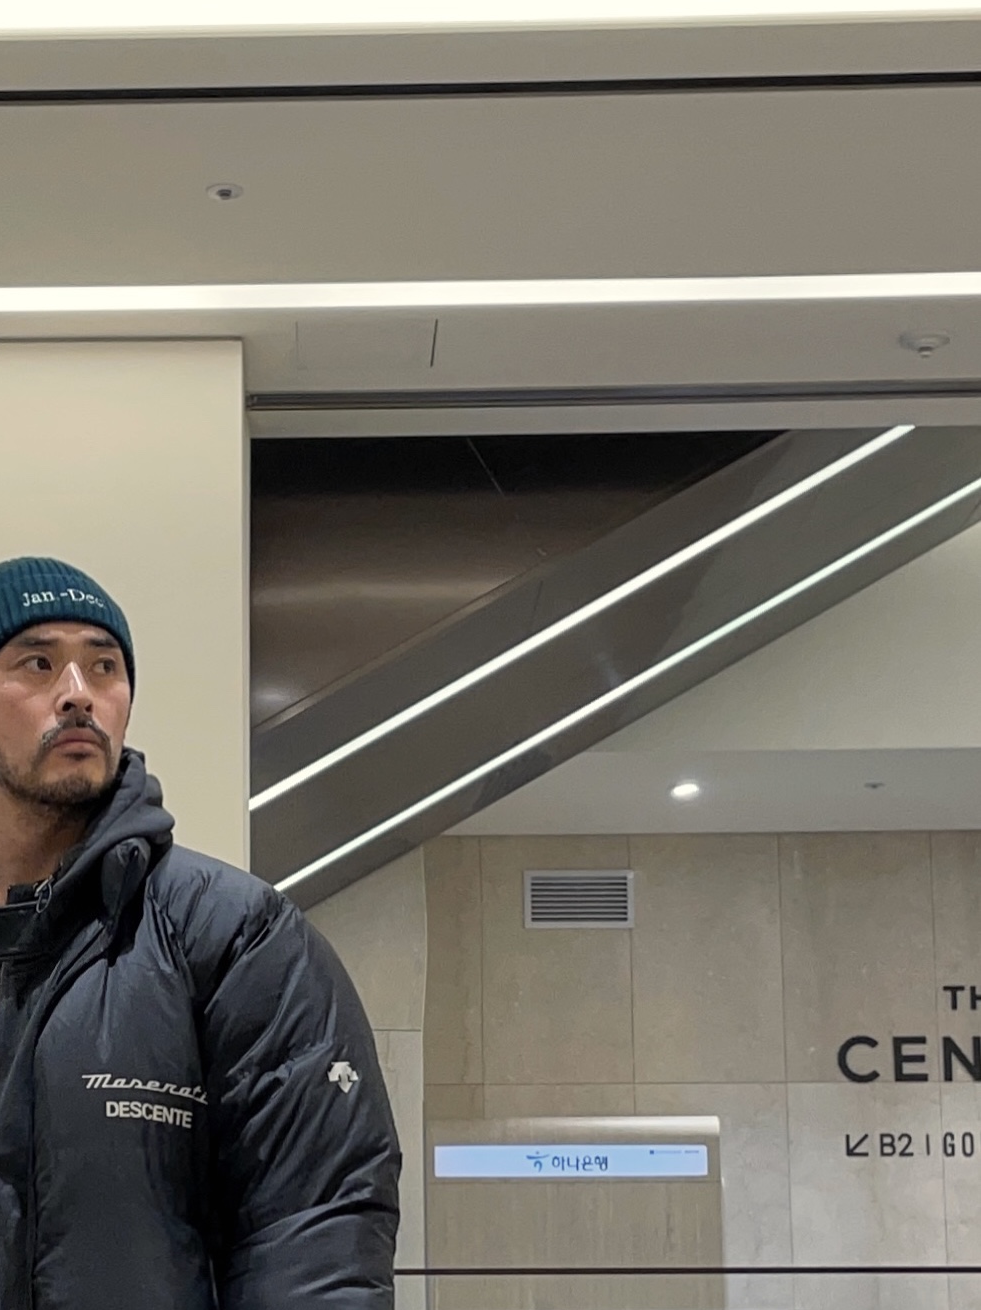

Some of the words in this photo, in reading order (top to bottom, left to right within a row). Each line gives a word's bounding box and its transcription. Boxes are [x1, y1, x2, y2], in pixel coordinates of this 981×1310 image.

[837, 1035, 981, 1083] CEN
[81, 1073, 209, 1105] Maserati
[105, 1101, 193, 1128] DESCENTE
[879, 1133, 914, 1157] B2
